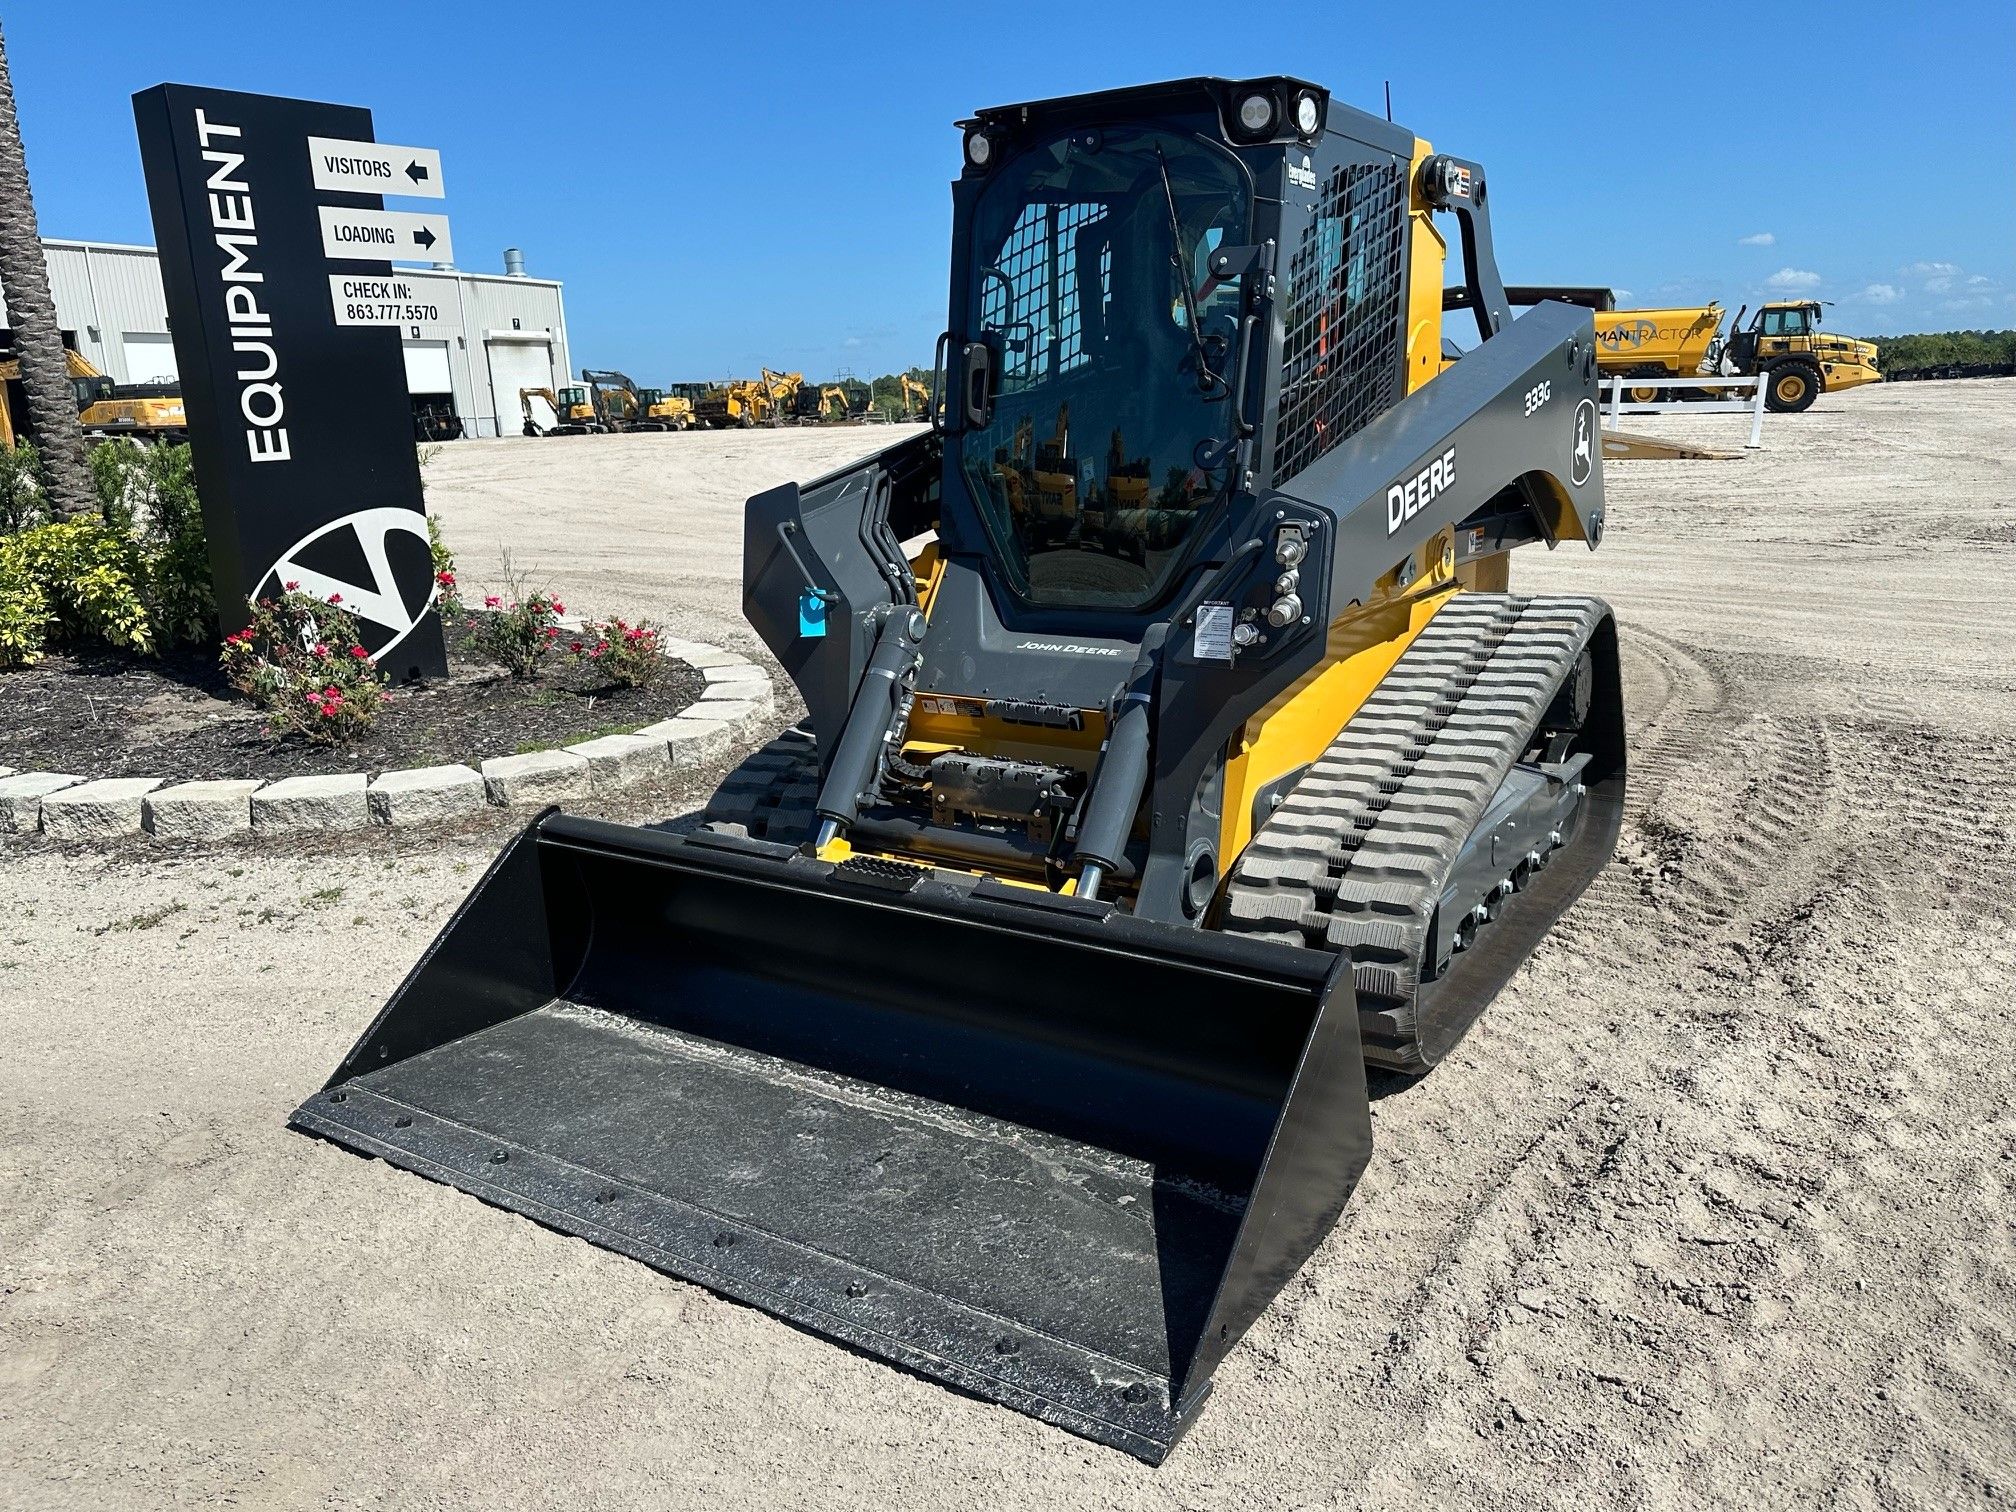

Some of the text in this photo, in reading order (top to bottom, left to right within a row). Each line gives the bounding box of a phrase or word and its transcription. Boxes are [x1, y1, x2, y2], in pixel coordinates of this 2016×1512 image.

[324, 155, 392, 178] VISITORS
[334, 224, 395, 244] LOADING
[195, 108, 292, 462] EQUIPMENT
[343, 281, 412, 299] CHECK IN:
[347, 304, 438, 321] 863.777.5570
[1524, 379, 1551, 418] 333G
[1387, 447, 1456, 535] DEERE
[1016, 641, 1122, 656] JOHN DEERE
